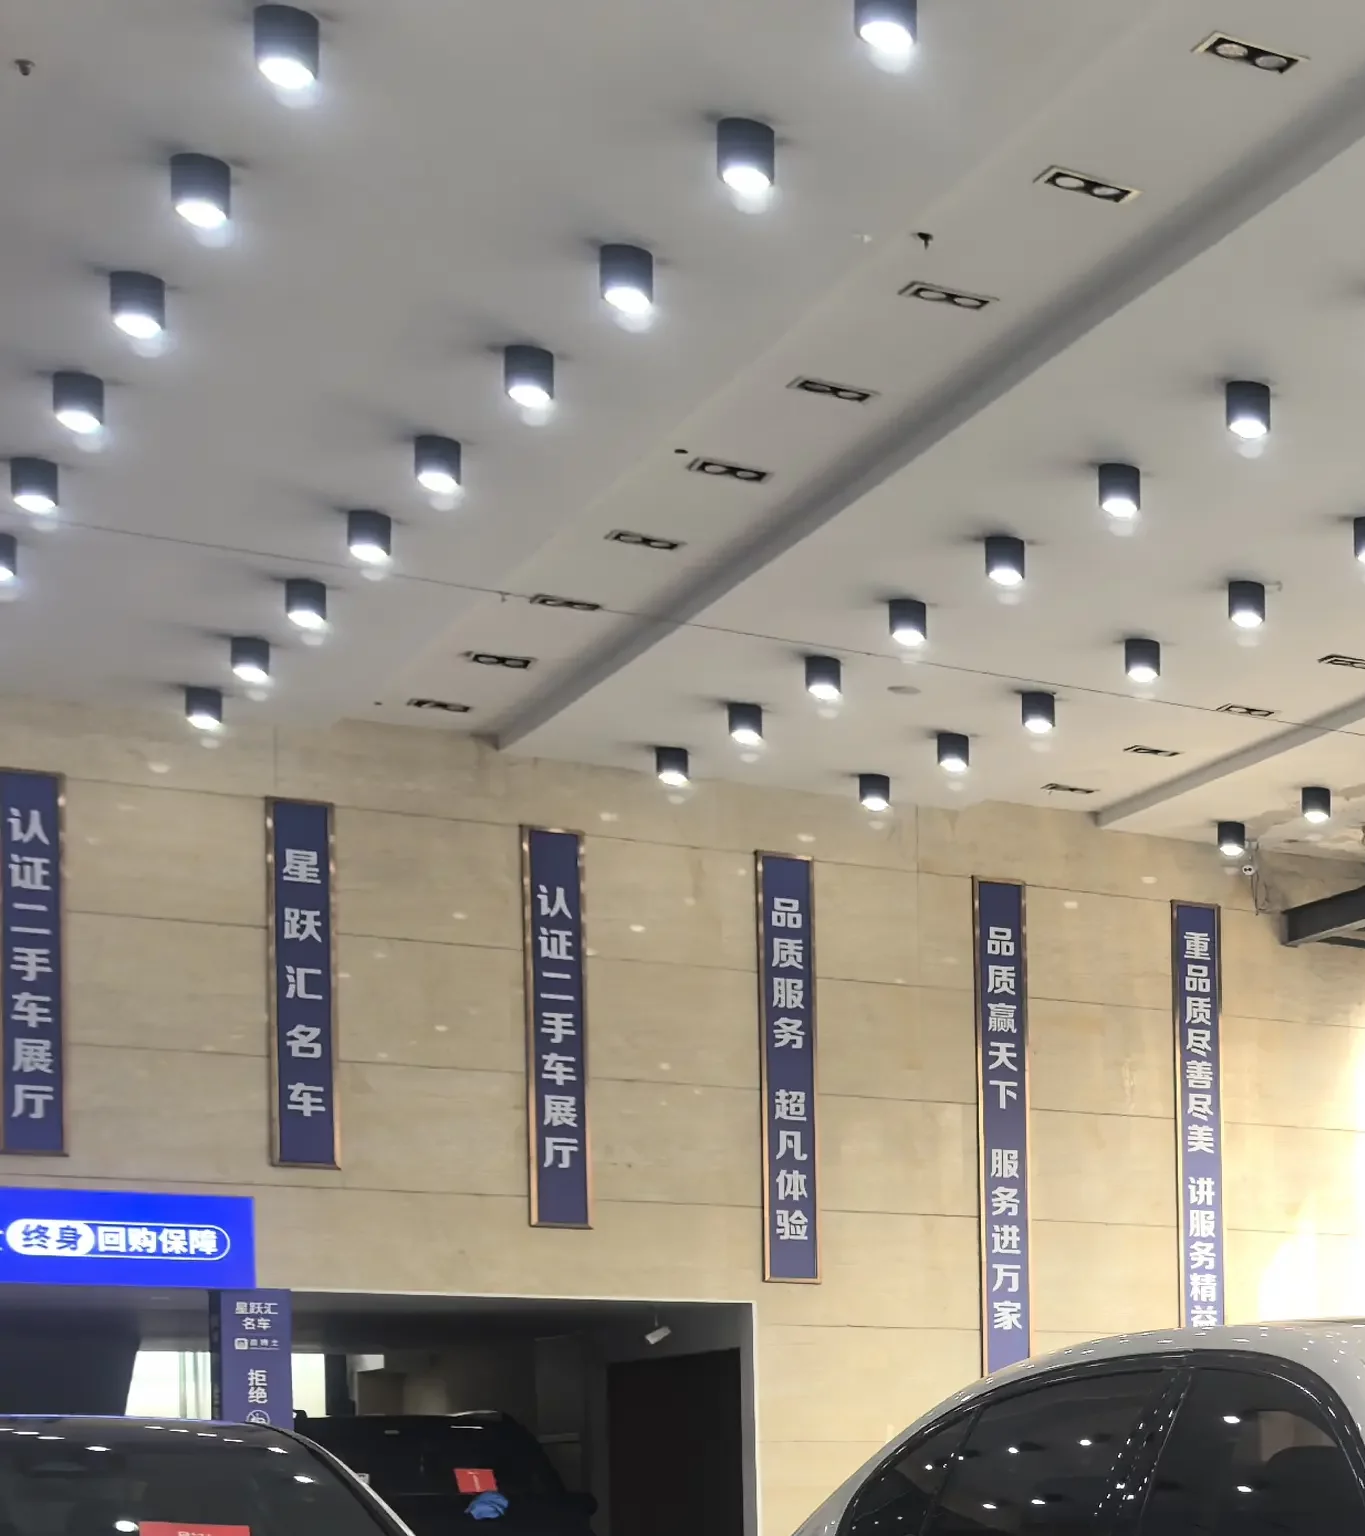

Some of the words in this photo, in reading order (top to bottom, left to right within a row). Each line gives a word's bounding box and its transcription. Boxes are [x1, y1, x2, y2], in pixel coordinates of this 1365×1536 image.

[9, 808, 53, 1119] 认证二手车展厅
[282, 848, 325, 1117] 星跃汇名车
[537, 885, 578, 1169] 认证二手车展厅
[771, 897, 804, 1050] 品质服务
[986, 926, 1017, 1109] 品质赢天下
[1183, 931, 1215, 1155] 重品质尽善尽美
[21, 1222, 219, 1257] 终身回购保障
[775, 1089, 808, 1241] 超凡体验
[990, 1147, 1022, 1331] 服务进万家
[235, 1301, 278, 1315] 星跃汇
[242, 1316, 272, 1331] 名车
[247, 1368, 268, 1404] 拒绝
